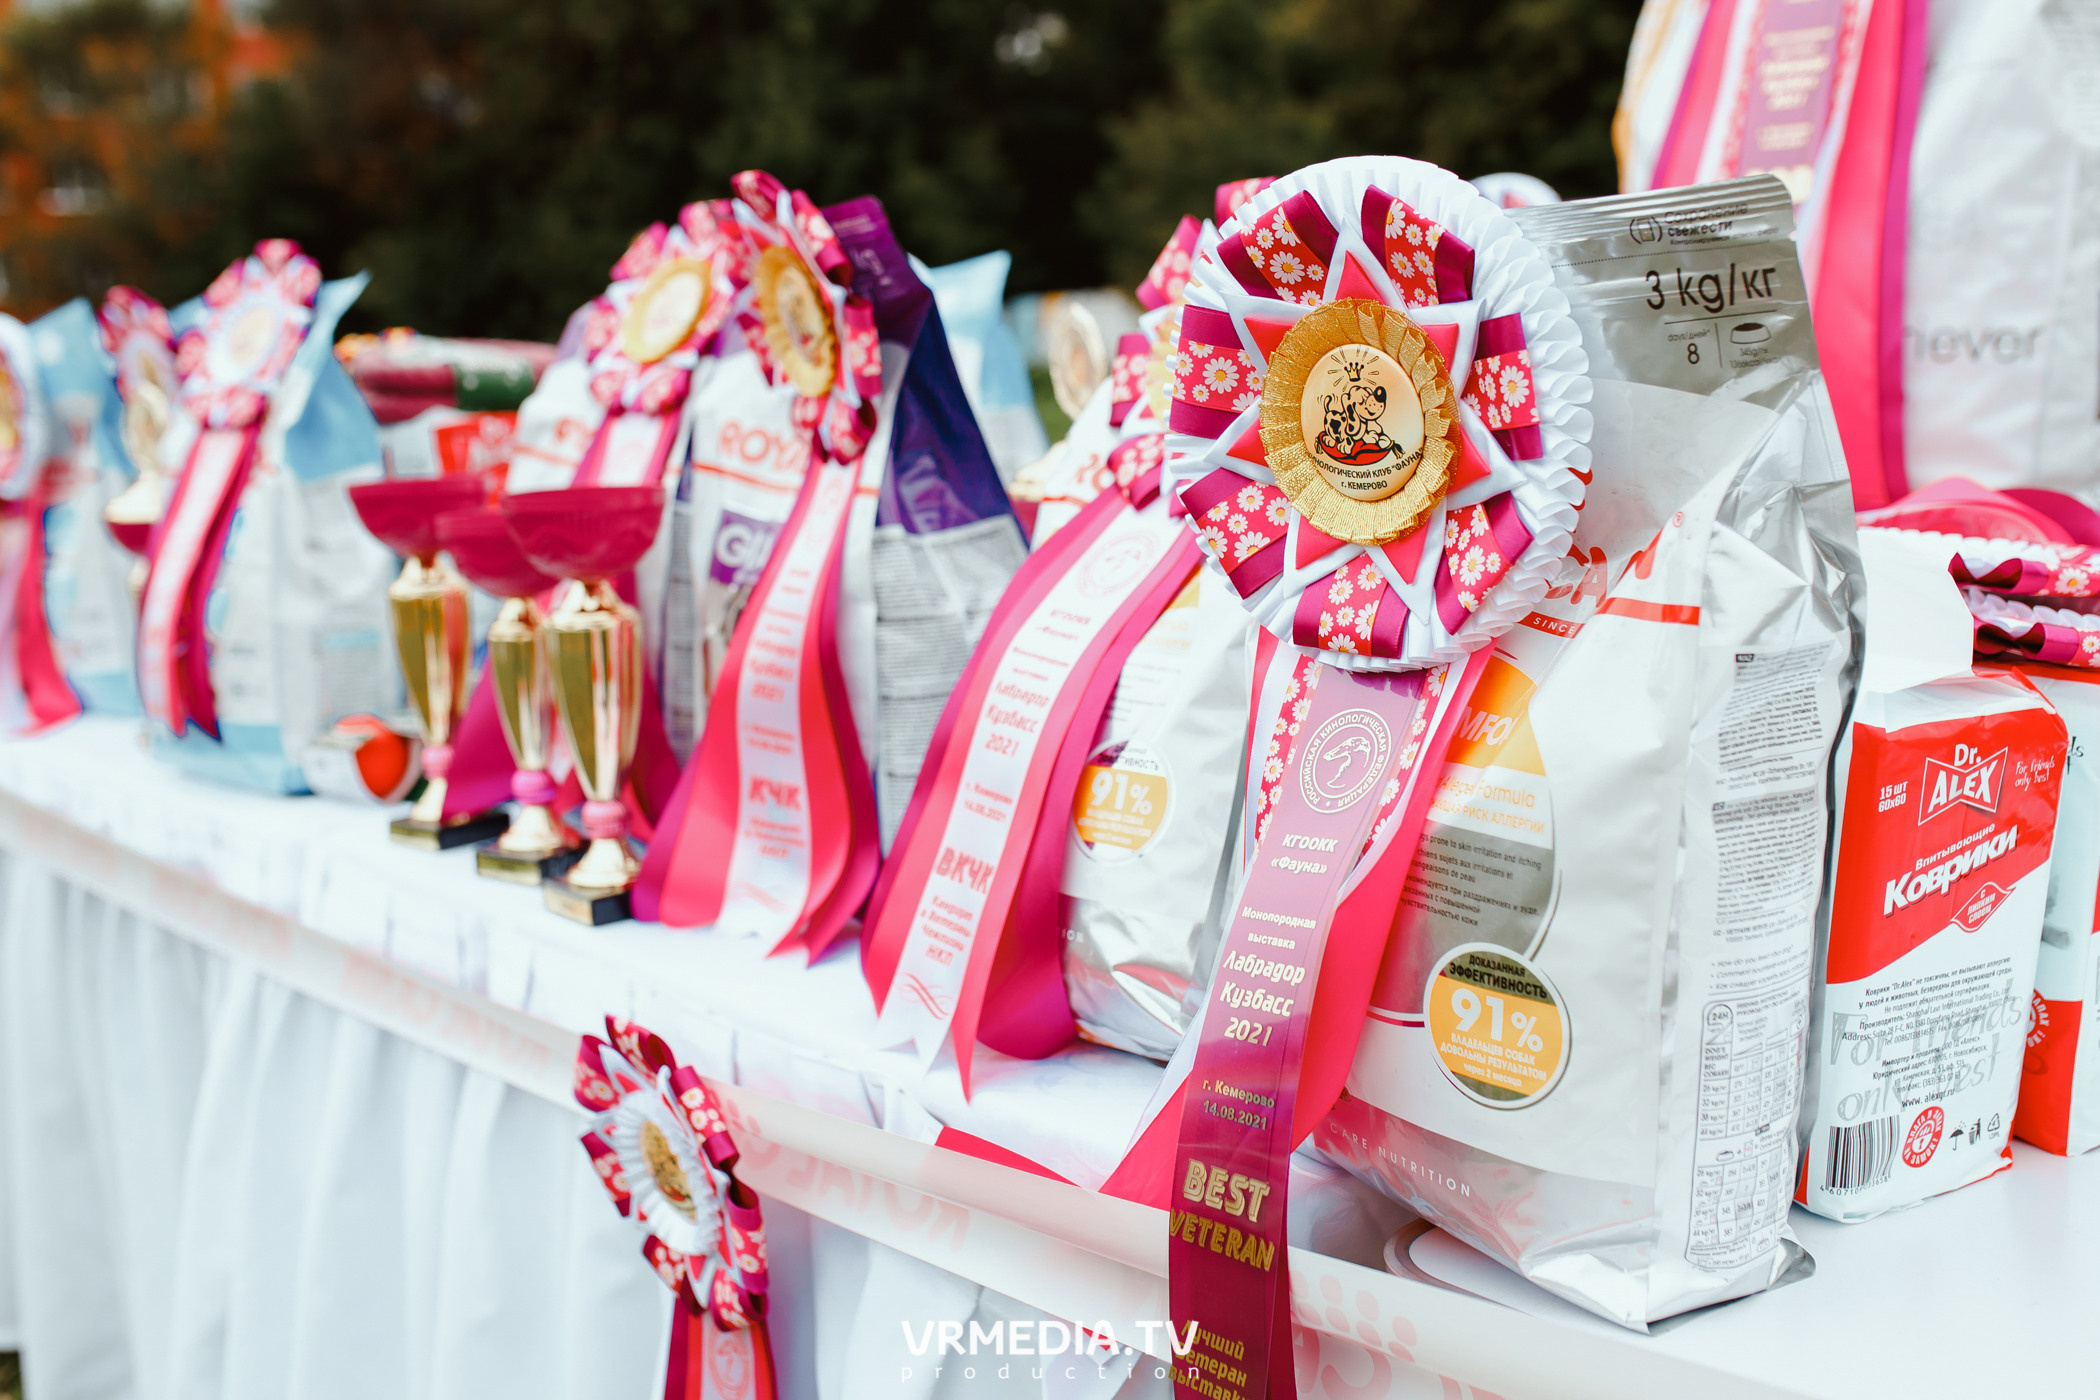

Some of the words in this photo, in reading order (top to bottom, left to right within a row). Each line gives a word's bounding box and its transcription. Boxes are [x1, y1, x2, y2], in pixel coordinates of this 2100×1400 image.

[1668, 221, 1733, 237] свежести
[1645, 270, 1665, 310] 3
[1687, 343, 1699, 364] 8
[1348, 480, 1388, 491] КЕМЕРОВО
[1372, 466, 1392, 479] КЛУБ
[1533, 617, 1576, 635] SINCE
[985, 732, 1020, 758] 2021
[1319, 714, 1387, 752] КИНОЛОГИЧЕСКАЯ
[1954, 744, 1981, 766] Dr.
[2015, 761, 2028, 775] For
[2030, 755, 2056, 772] friends
[1303, 738, 1322, 805] РОССИЙСКАЯ
[1337, 755, 1385, 807] ФЕДЕРАЦИЯ
[2014, 776, 2031, 792] only
[2034, 769, 2050, 784] best
[1091, 771, 1153, 815] 91%
[1476, 779, 1536, 808] Formula
[1879, 786, 1893, 800] 15
[1894, 781, 1908, 793] шт
[1927, 759, 1999, 814] ALEX
[1462, 806, 1488, 821] РИСК
[1491, 812, 1545, 834] АЛЛЕРГИИ
[1282, 833, 1338, 852] КГООКК
[1430, 834, 1449, 847] prone
[1451, 839, 1457, 847] to
[1458, 840, 1472, 851] skin
[1473, 845, 1502, 860] irritation
[1503, 853, 1516, 864] and
[1519, 855, 1542, 871] itching
[1916, 823, 1996, 871] Впитывающие
[935, 846, 996, 895] ВКЧК
[1271, 856, 1327, 874] «Фауна»
[1439, 852, 1459, 866] sujets
[1460, 859, 1471, 869] aux
[1472, 861, 1505, 878] irritations
[1506, 872, 1514, 881] et
[1451, 867, 1458, 877] de
[1460, 870, 1476, 883] peau
[1883, 824, 2018, 916] Коврики
[1450, 885, 1462, 896] при
[1242, 906, 1316, 930] Монопородная
[1440, 897, 1481, 914] повышенной
[1461, 916, 1479, 927] кожи
[1247, 932, 1296, 950] выставка
[1223, 950, 1306, 986] Лабрадор
[1468, 954, 1526, 978] ДОКАЗАННАЯ
[1865, 986, 1890, 997] Коврики
[1892, 978, 1915, 990] "Dr.Alex"
[1916, 977, 1923, 985] не
[1959, 963, 1986, 975] вызывают
[1449, 962, 1547, 999] ЭФФЕКТИВНОСТЬ
[1859, 1001, 1864, 1009] у
[1865, 997, 1884, 1008] людей
[1920, 982, 1949, 994] безвредны
[1950, 980, 1960, 988] для
[1961, 971, 1996, 985] окружающей
[1219, 981, 1294, 1017] Кузбасс
[1892, 1000, 1918, 1012] подлежит
[1224, 1016, 1273, 1047] 2021
[1451, 988, 1543, 1052] 91%
[1859, 1014, 1905, 1030] Производитель:
[1451, 1032, 1503, 1056] ВЛАДЕЛЬЦЕВ
[1504, 1048, 1536, 1065] СОБАК
[1830, 1012, 1890, 1066] For
[1841, 1031, 1871, 1041] Address:
[1440, 1042, 1486, 1064] ДОВОЛЬНЫ
[1488, 1056, 1547, 1081] РЕЗУЛЬТАТОМ
[1463, 1063, 1485, 1077] через
[1486, 1069, 1491, 1079] 2
[1492, 1071, 1522, 1087] месяца
[1872, 1064, 1911, 1080] Юридический
[1882, 1055, 1910, 1067] Импортер
[1202, 1079, 1211, 1090] г.
[1215, 1079, 1275, 1109] Кемерово
[1901, 1097, 1923, 1108] www.
[1203, 1100, 1268, 1131] 14.08.2021
[1330, 1122, 1368, 1150] CARE
[1378, 1146, 1471, 1197] NUTRITION
[1183, 1158, 1270, 1223] BEST
[1169, 1206, 1275, 1272] VETERAN
